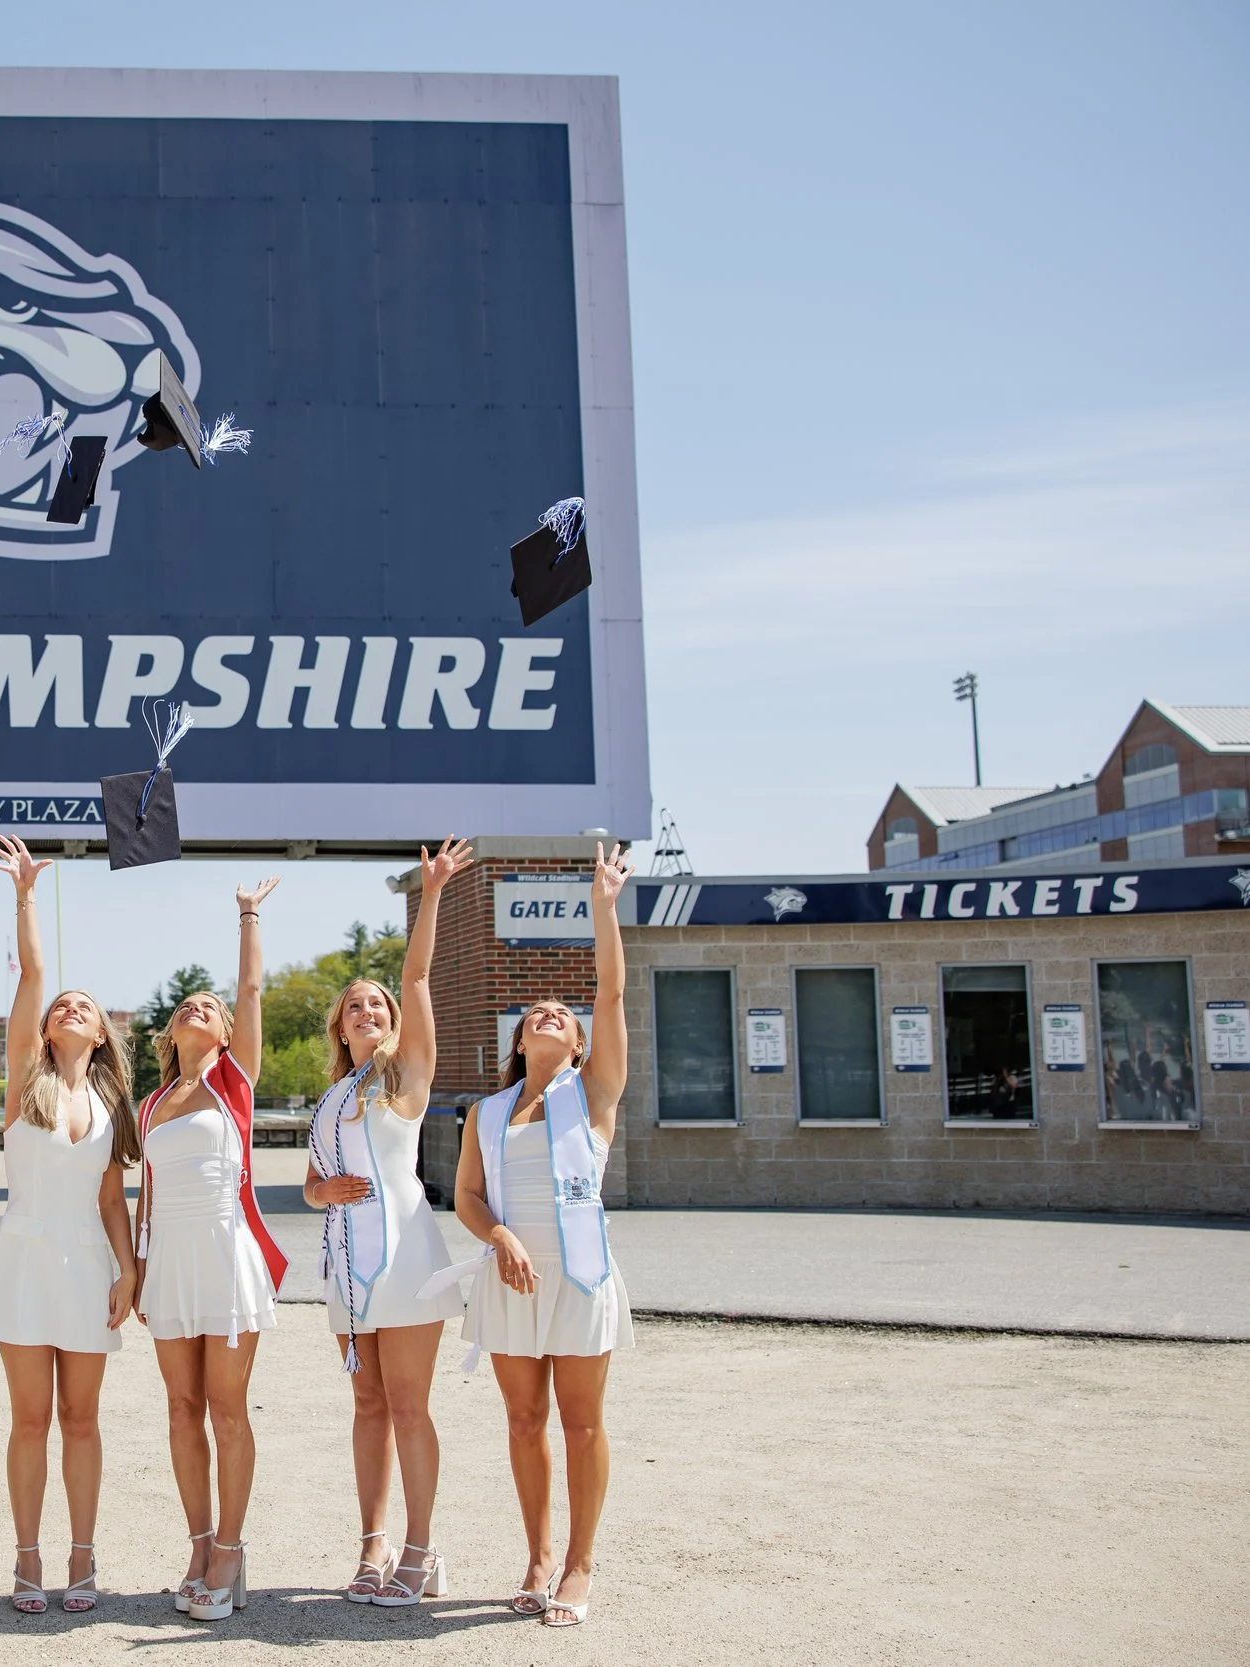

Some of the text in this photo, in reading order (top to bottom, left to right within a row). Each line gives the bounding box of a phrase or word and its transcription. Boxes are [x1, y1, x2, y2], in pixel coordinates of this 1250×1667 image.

[11, 800, 103, 822] PLAZA
[517, 874, 581, 882] Wildcat Stadium
[885, 875, 1139, 920] TICKETS
[510, 901, 588, 919] GATE A
